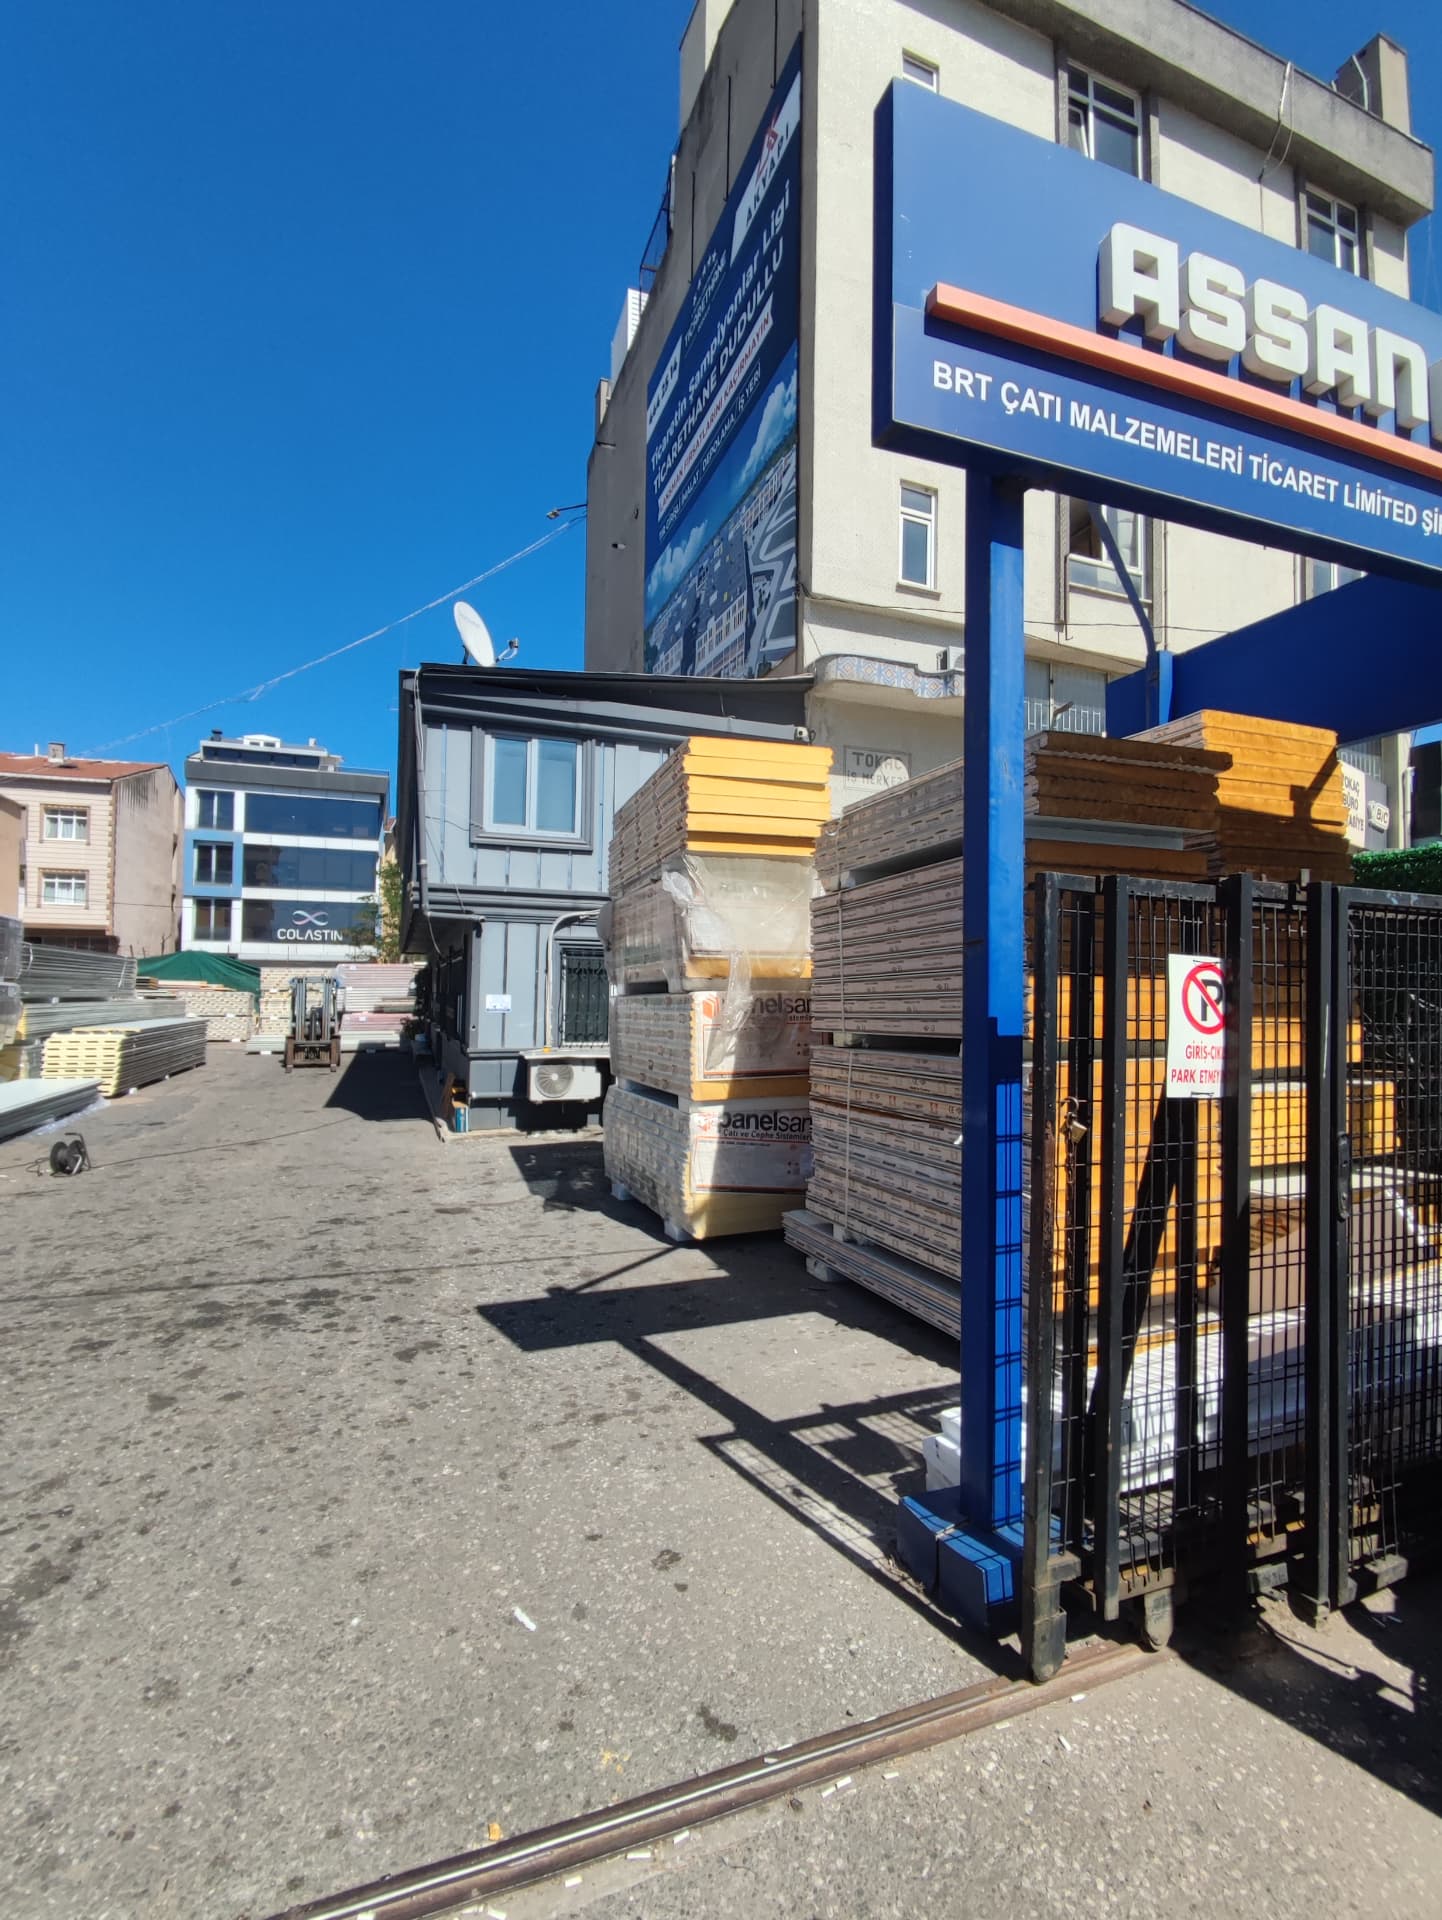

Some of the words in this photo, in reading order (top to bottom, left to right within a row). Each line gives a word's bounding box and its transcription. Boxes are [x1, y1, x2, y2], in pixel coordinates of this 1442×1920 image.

[746, 121, 789, 227] AKYAPI
[651, 396, 687, 471] Ticaretin
[688, 249, 760, 403] Şampiyonlar
[763, 178, 790, 256] Ligi
[653, 365, 718, 494] TİCARETHANE
[719, 236, 784, 376] DUDULLU
[1100, 222, 1442, 440] ASSAN
[933, 360, 993, 401] BRT
[1001, 381, 1062, 422] ÇATI
[1069, 400, 1243, 475] MALZEMELERİ
[1249, 453, 1339, 503] TİCARET
[1343, 482, 1418, 527] LİMİTED
[276, 927, 343, 942] COLASTIN
[1170, 1068, 1196, 1084] PARK
